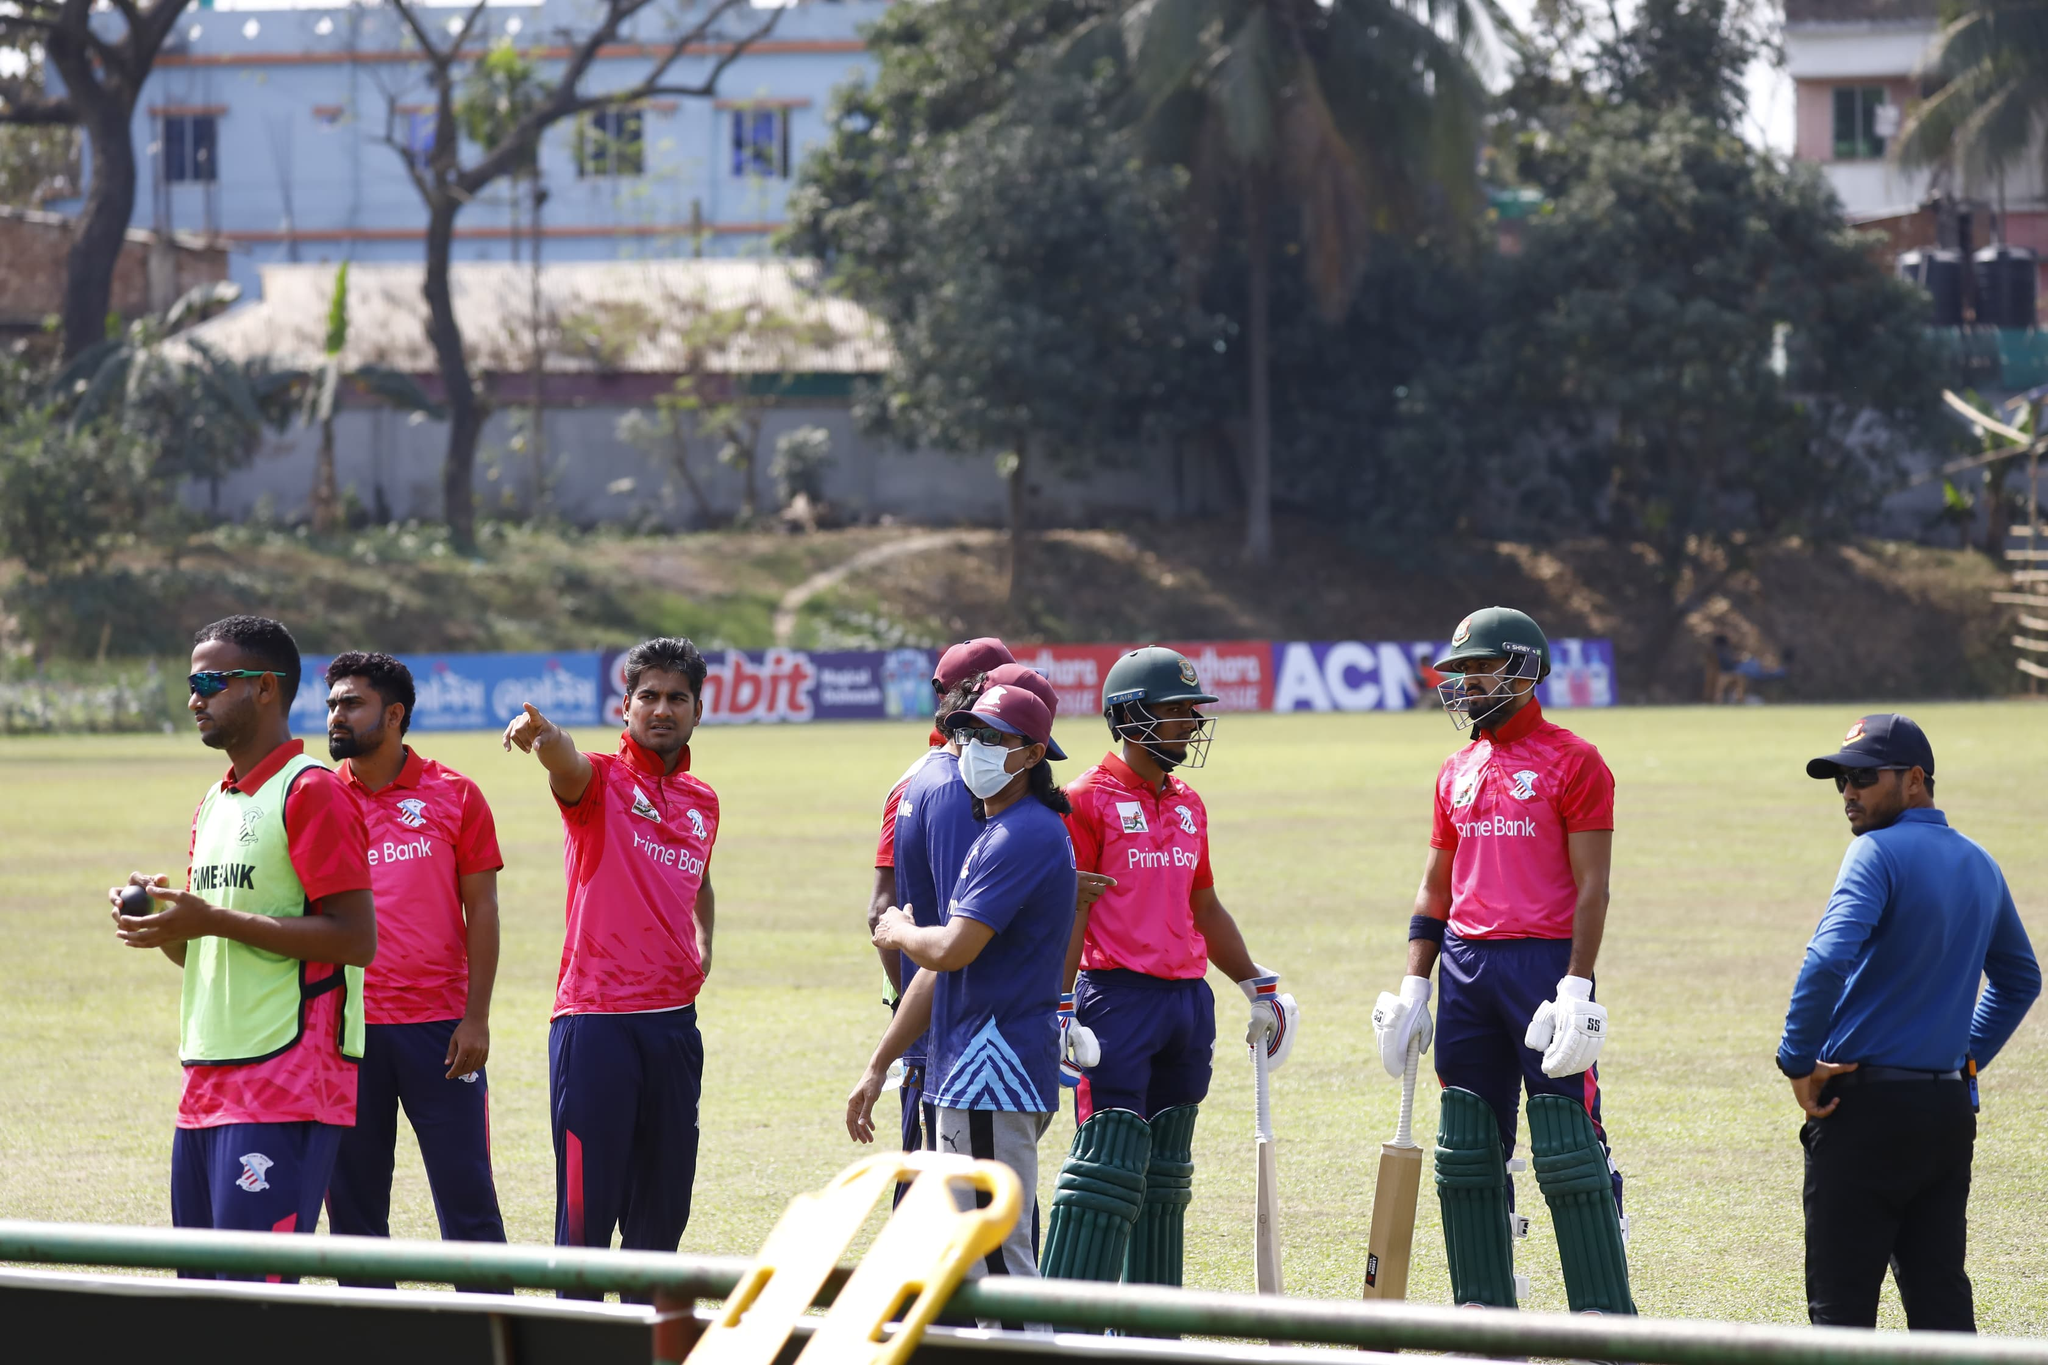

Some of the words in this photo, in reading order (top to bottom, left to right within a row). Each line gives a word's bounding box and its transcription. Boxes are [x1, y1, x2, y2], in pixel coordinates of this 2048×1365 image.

[1119, 693, 1133, 701] AIR
[1494, 815, 1536, 838] Bank
[383, 836, 432, 863] Bank
[1127, 846, 1170, 869] Prime
[677, 848, 707, 880] Ban
[1586, 1017, 1601, 1032] SS
